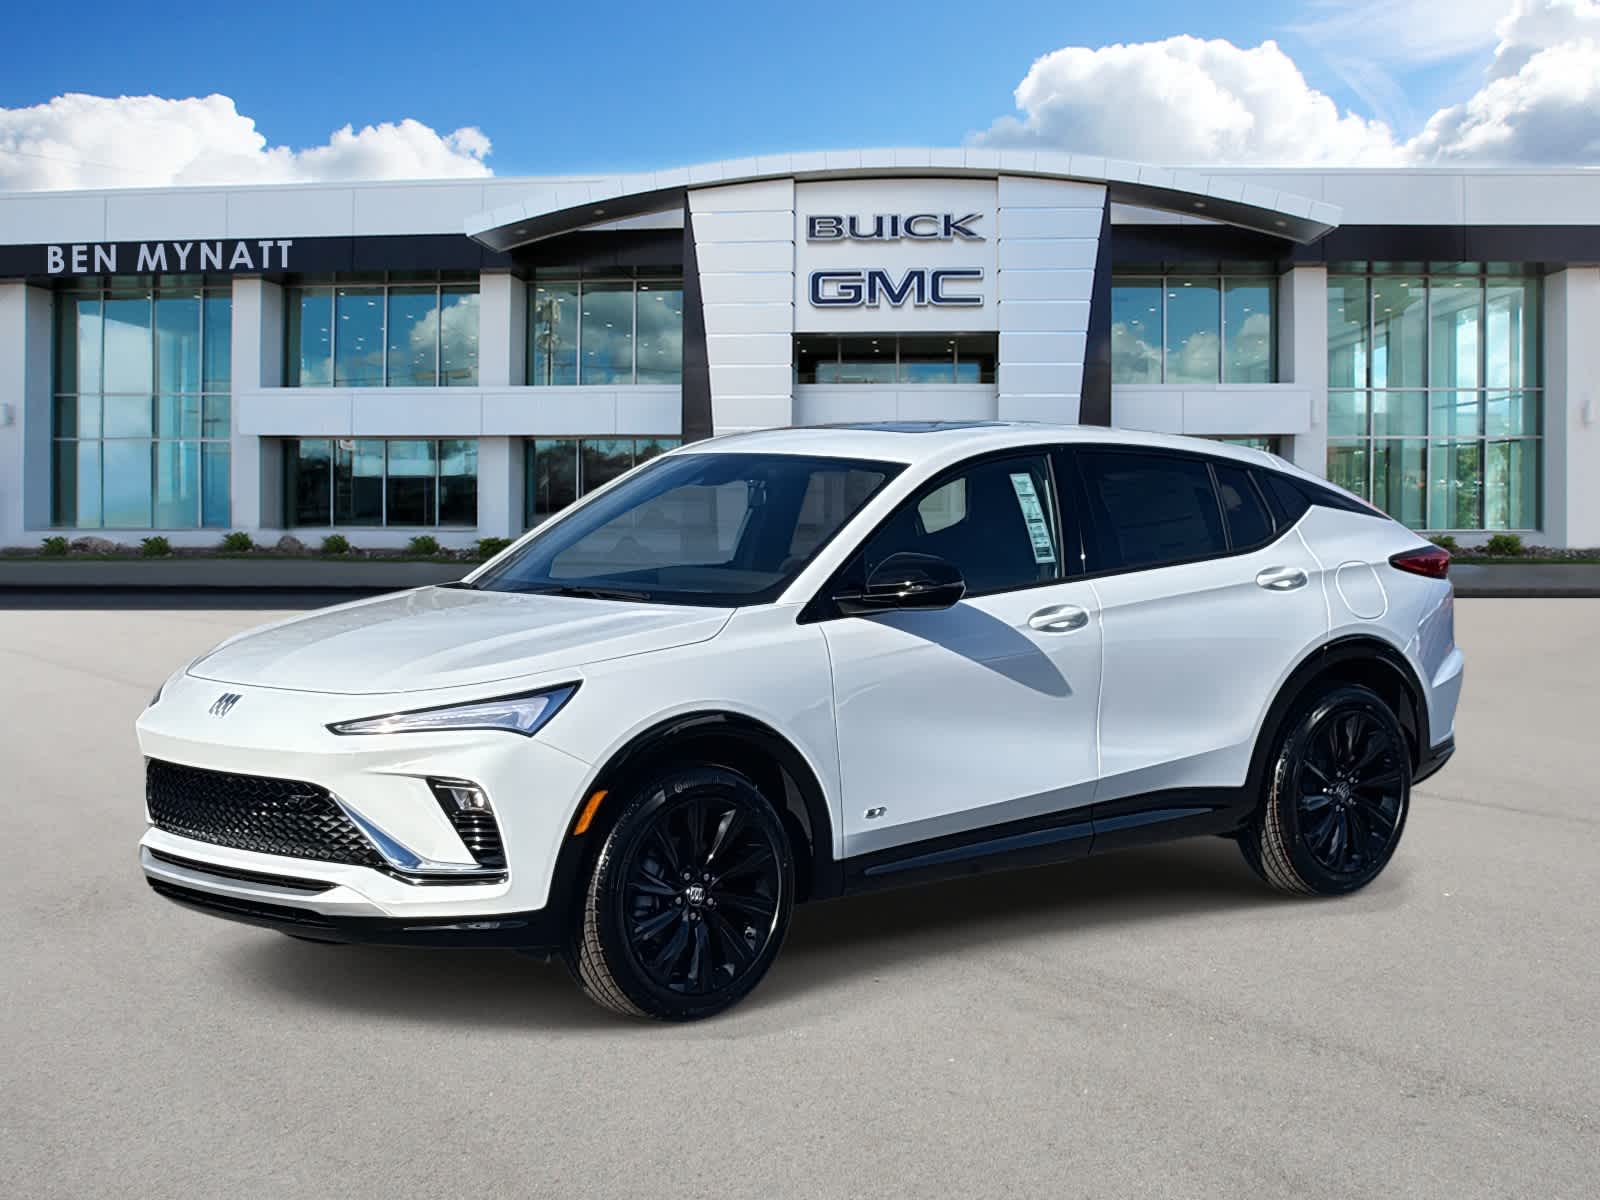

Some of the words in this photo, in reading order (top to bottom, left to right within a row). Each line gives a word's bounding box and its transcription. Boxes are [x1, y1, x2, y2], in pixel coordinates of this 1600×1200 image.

[807, 213, 985, 241] BUICK
[47, 244, 117, 274] BEN
[136, 240, 293, 272] MYNATT
[809, 267, 984, 308] GMC
